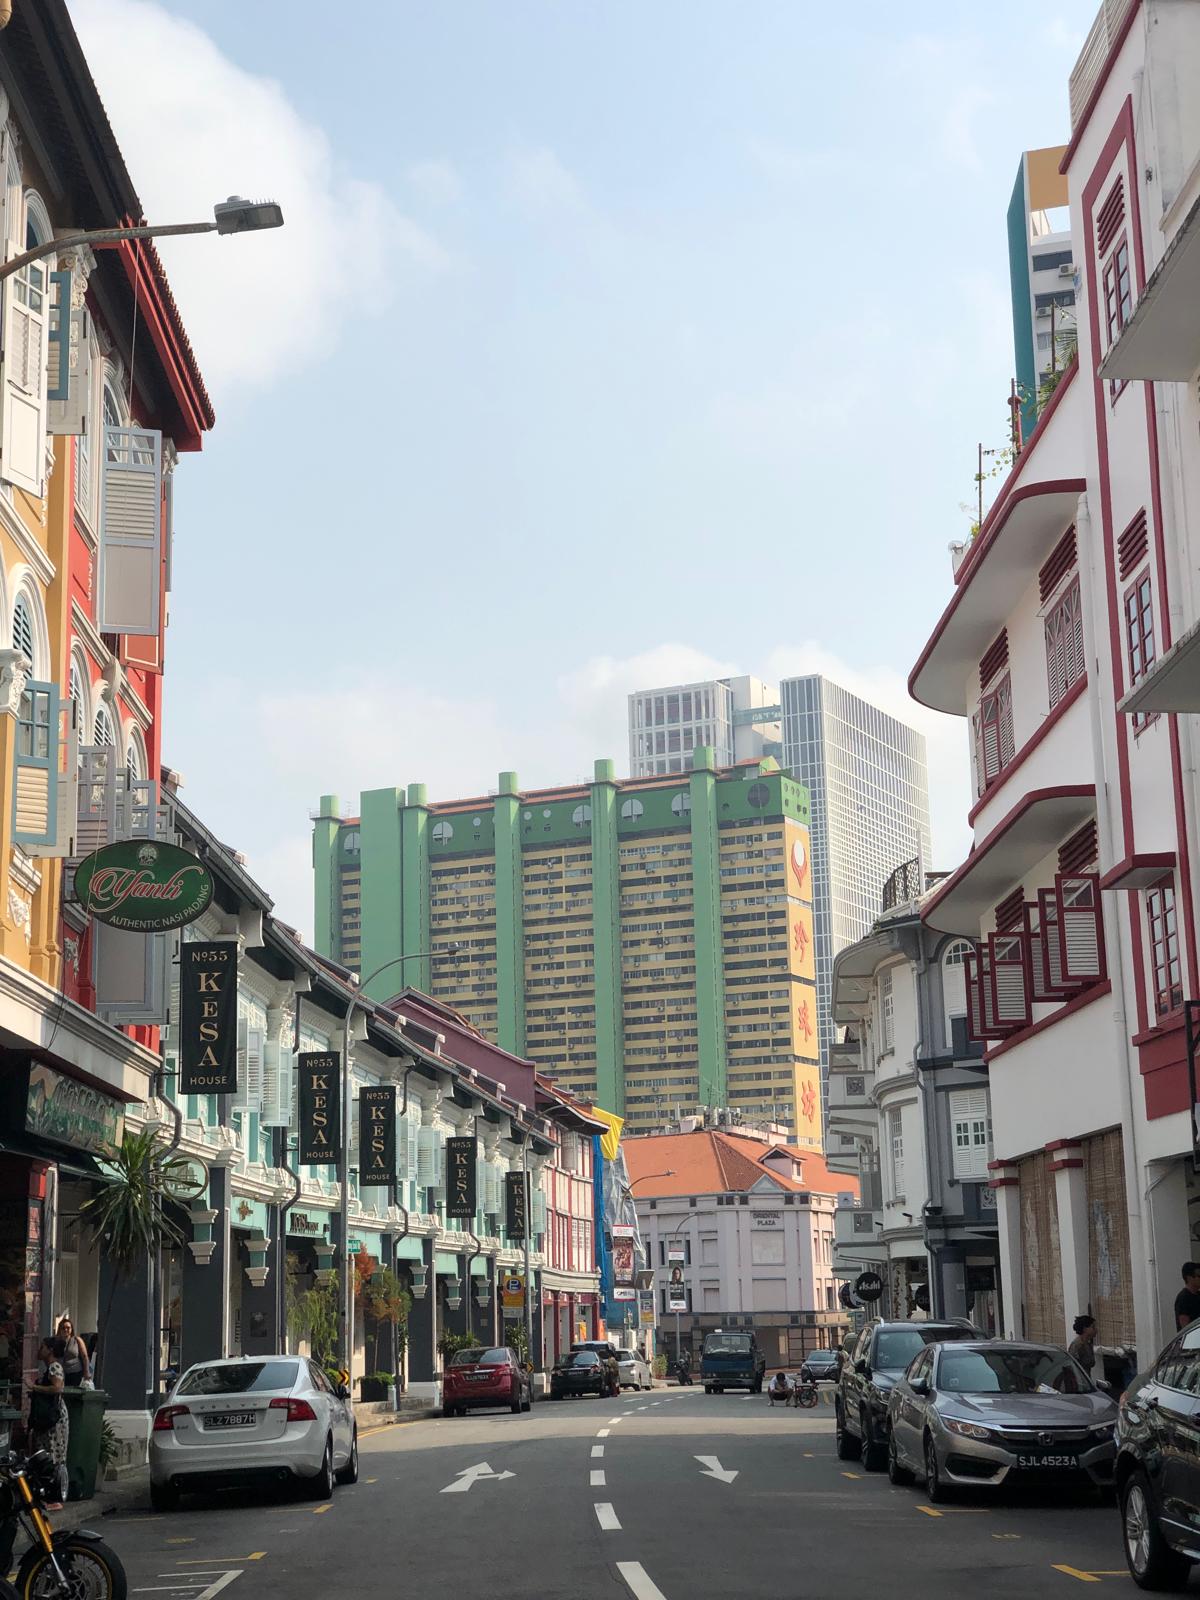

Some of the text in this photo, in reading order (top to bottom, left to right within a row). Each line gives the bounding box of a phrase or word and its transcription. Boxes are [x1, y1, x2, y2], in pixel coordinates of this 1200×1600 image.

[109, 884, 209, 929] AUTHENTIC NASI PADANG
[190, 1075, 228, 1086] HOUSE
[306, 1150, 335, 1159] HOUSE
[1019, 1455, 1078, 1467] SJL4523A
